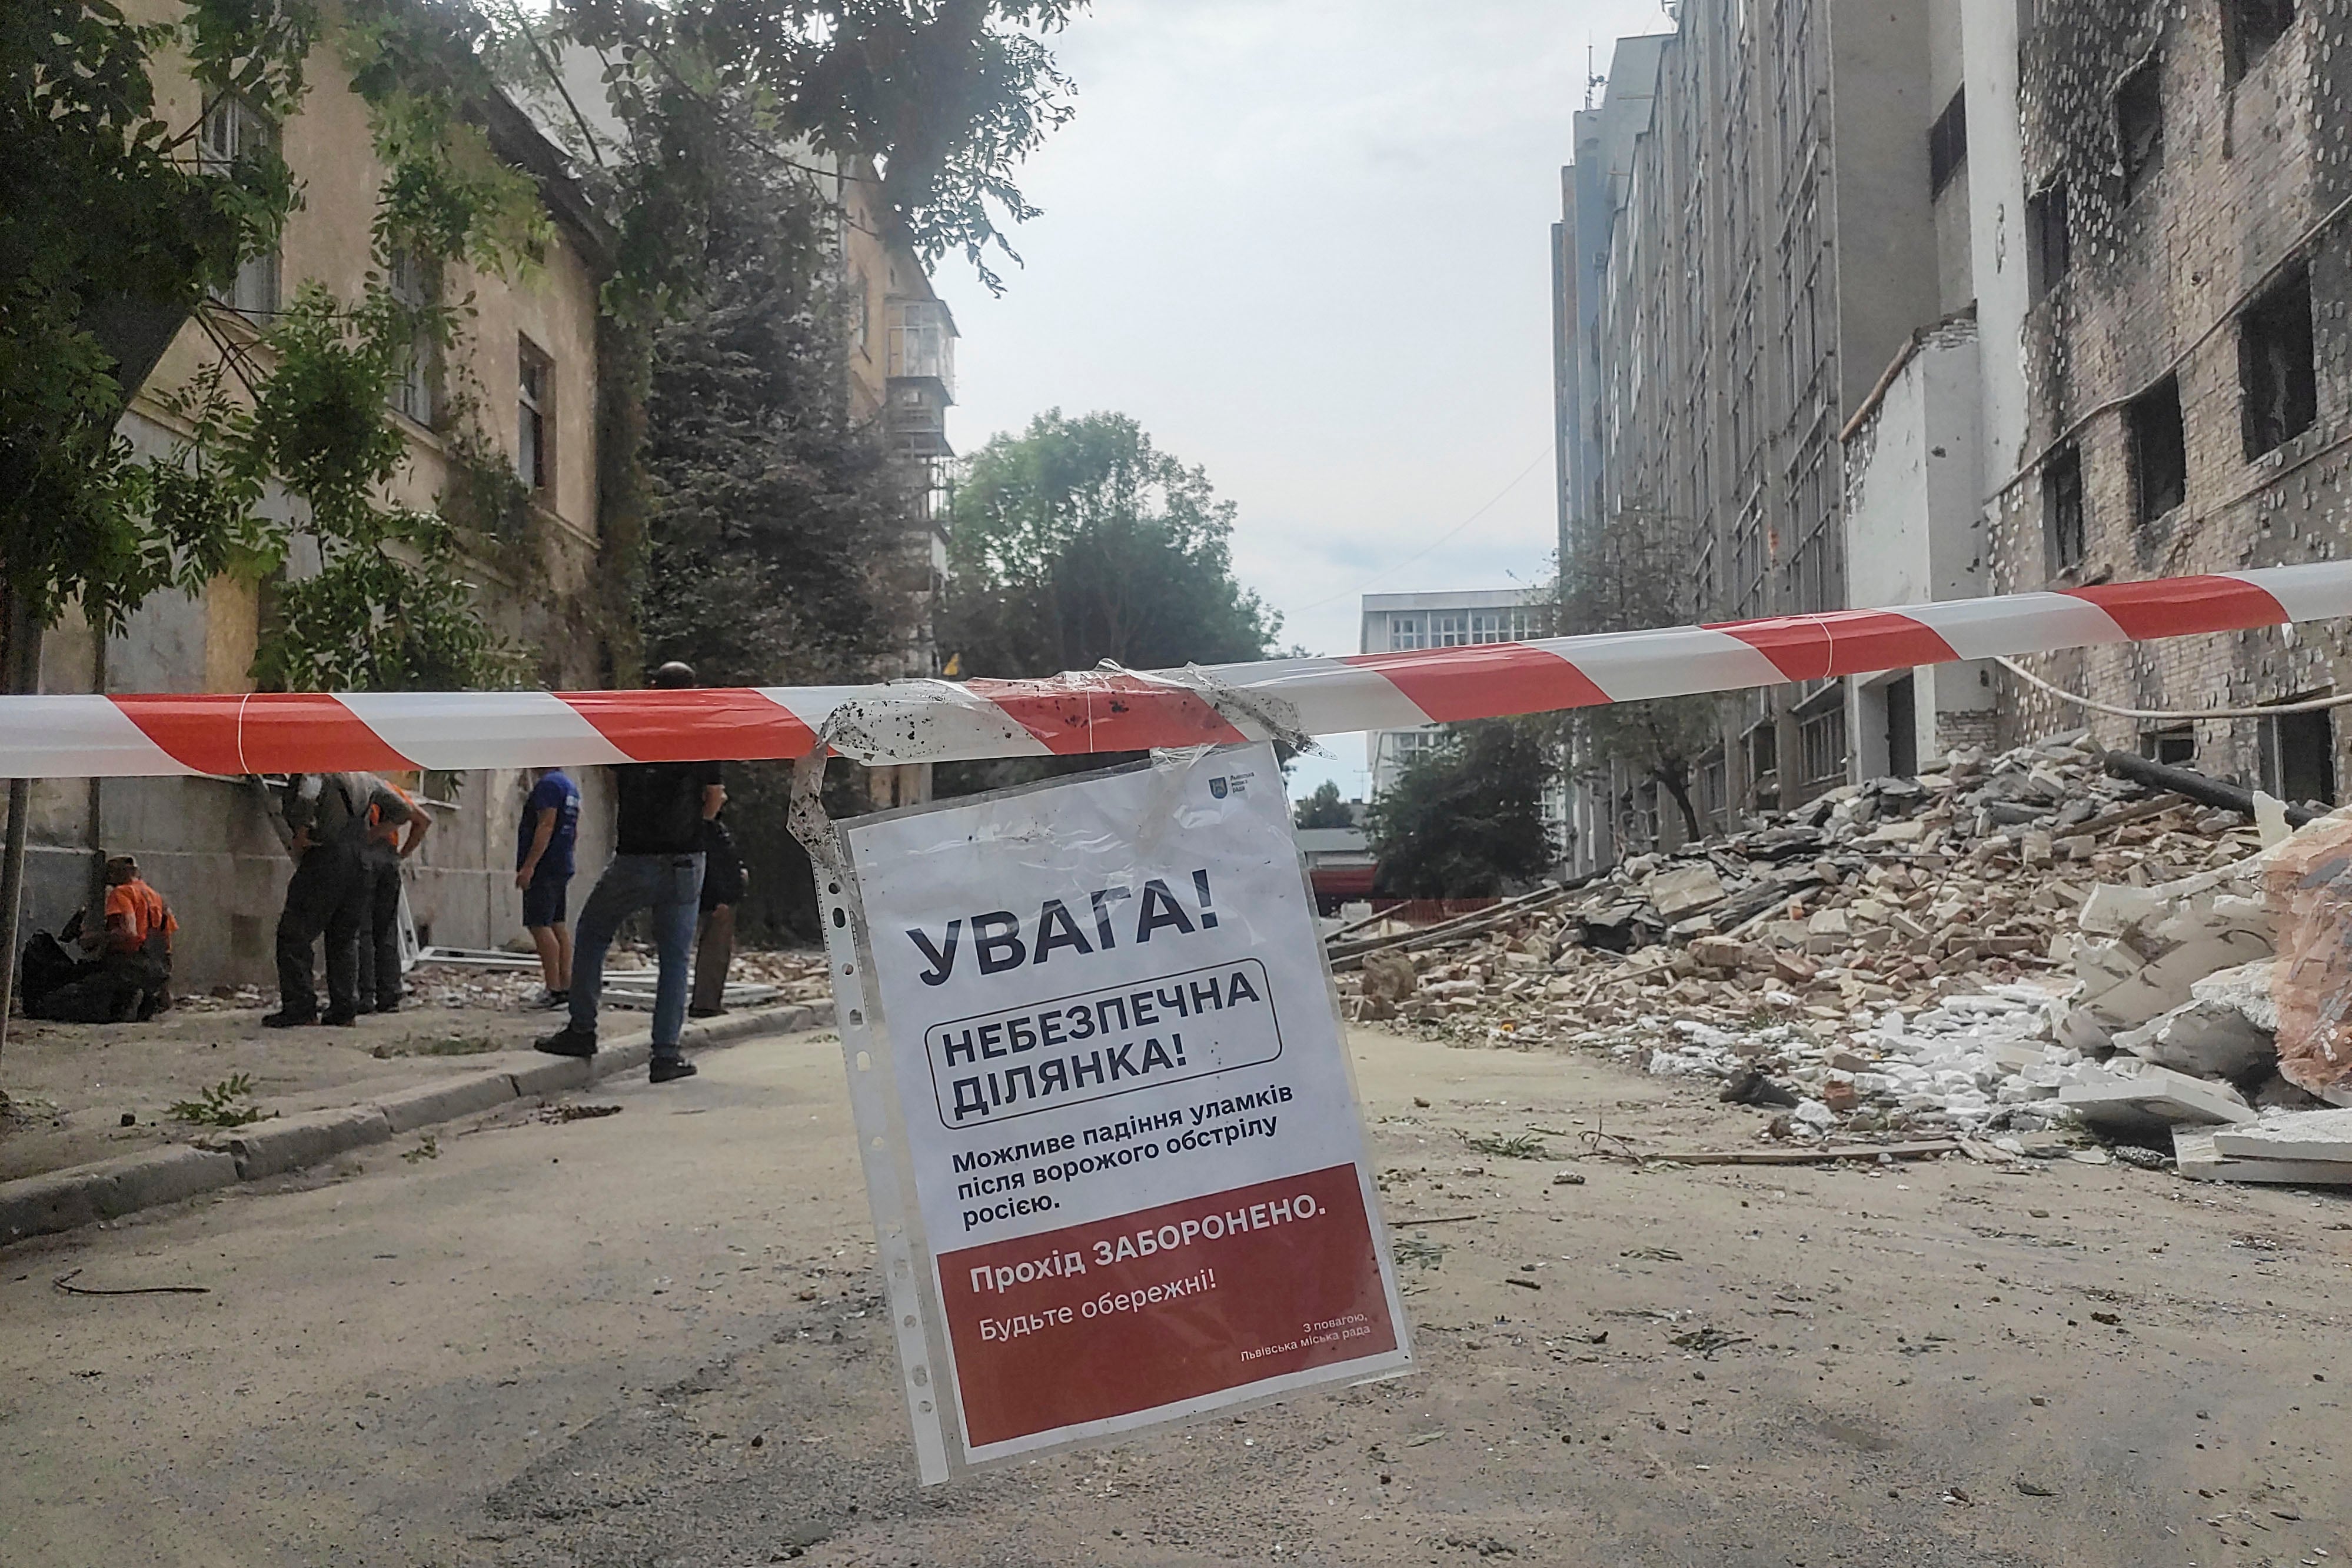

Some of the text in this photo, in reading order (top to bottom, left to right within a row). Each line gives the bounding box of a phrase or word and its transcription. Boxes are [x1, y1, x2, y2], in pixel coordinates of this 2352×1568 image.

[906, 869, 1218, 986] УВАГА!
[943, 972, 1260, 1067] НЕБЕЗПЕЧНА
[953, 1033, 1187, 1121] ДІЛЯНКА!
[952, 1084, 1293, 1173] Можливе падіння уламків
[957, 1116, 1278, 1200] після ворожого обстрілу
[963, 1196, 1060, 1231] росією.
[970, 1194, 1326, 1293] Прохід ЗАБОРОНЕНО.
[979, 1268, 1216, 1342] Будьте обережні!
[1240, 1325, 1370, 1361] Львівська міська рада
[1303, 1313, 1368, 1333] З повагою,
